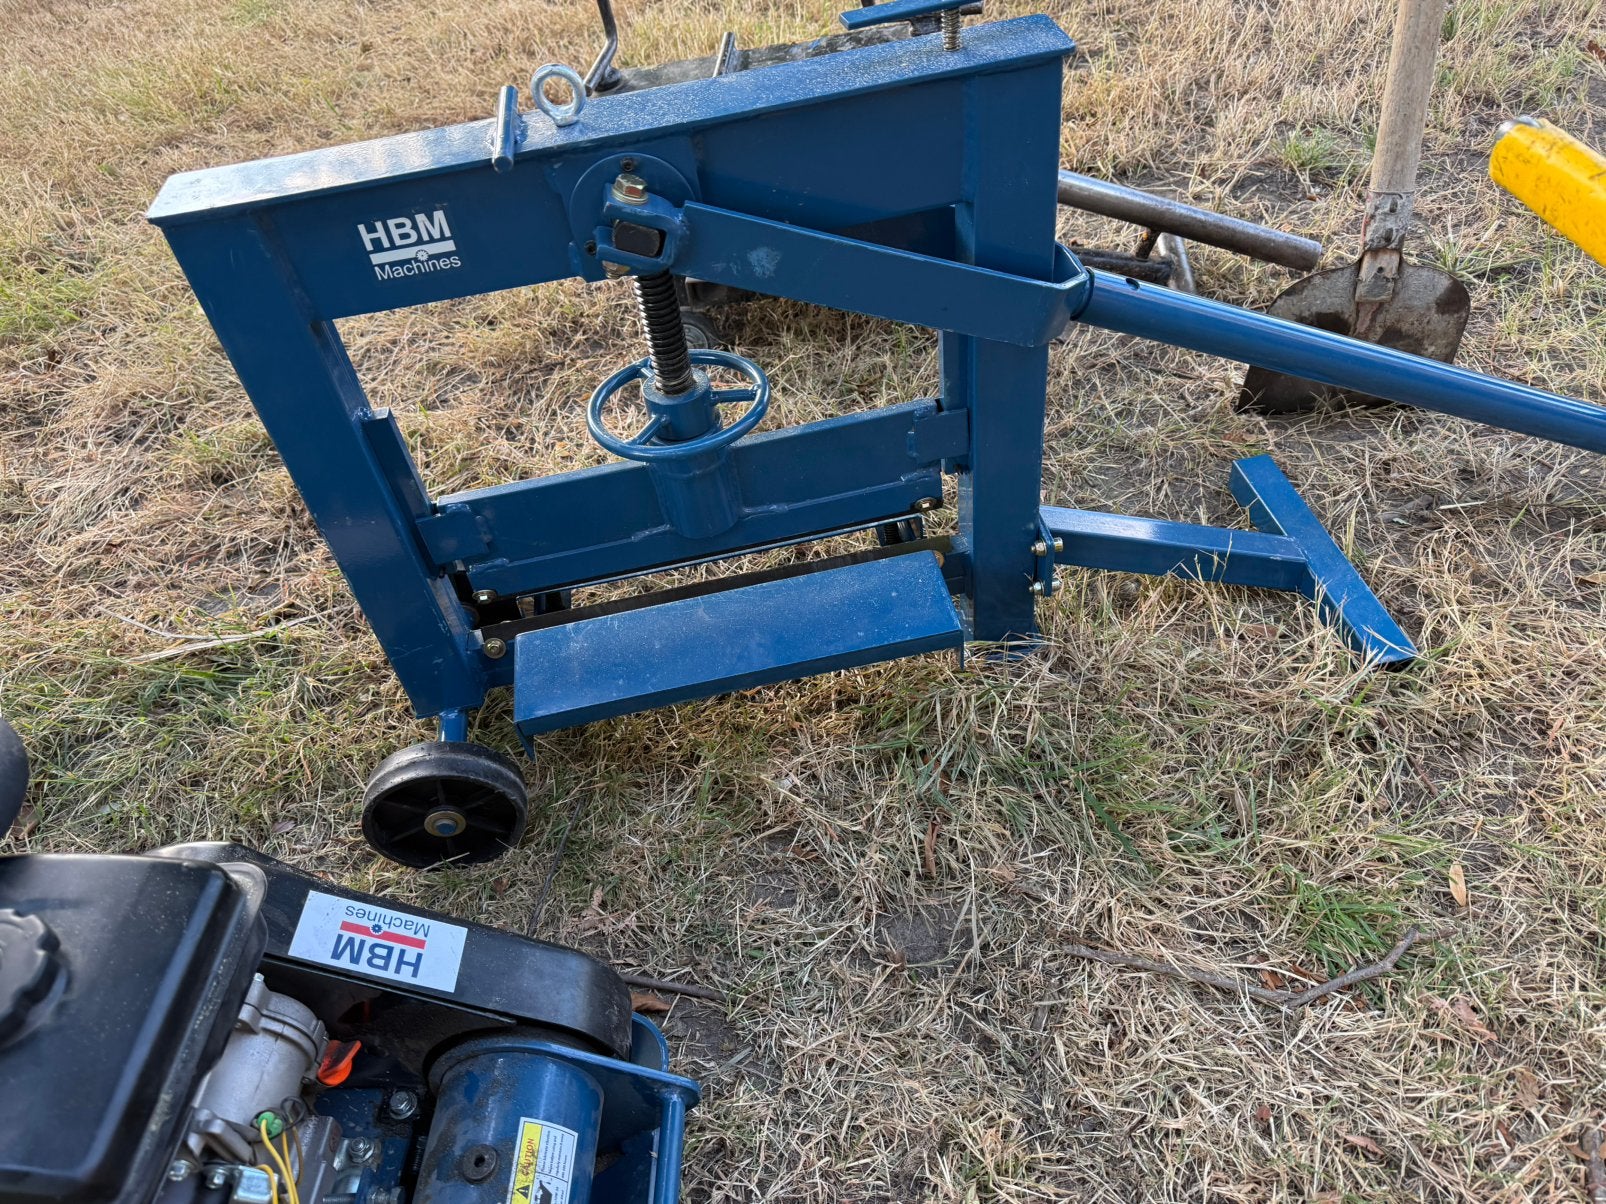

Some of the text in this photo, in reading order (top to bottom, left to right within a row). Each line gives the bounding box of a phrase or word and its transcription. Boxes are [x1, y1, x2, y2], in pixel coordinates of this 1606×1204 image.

[357, 210, 452, 251] HBM
[374, 256, 461, 280] Machines
[344, 905, 431, 938] Machines
[330, 933, 423, 979] HBM
